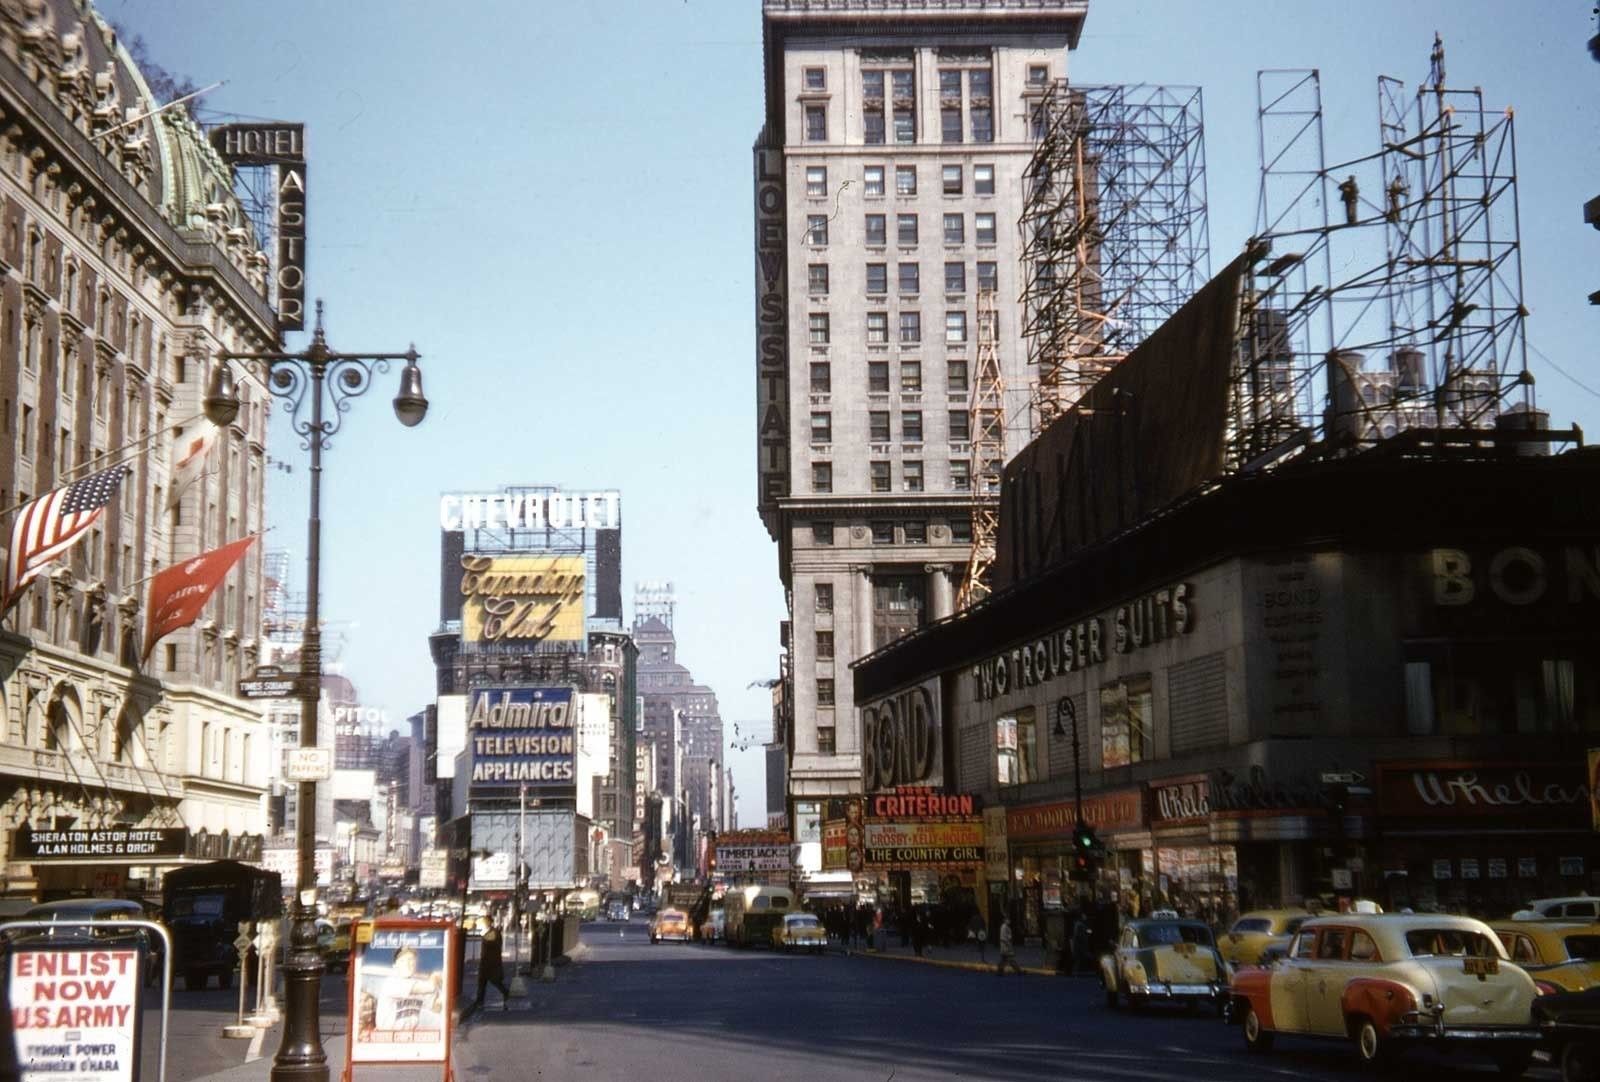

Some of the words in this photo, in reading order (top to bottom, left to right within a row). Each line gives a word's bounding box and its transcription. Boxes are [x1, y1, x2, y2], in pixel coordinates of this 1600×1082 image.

[226, 129, 304, 155] HOTEL
[277, 169, 305, 322] ASTOR
[758, 150, 785, 324] LOEW'S
[761, 335, 786, 498] STATE
[440, 491, 620, 531] CHEVROLET
[460, 553, 585, 602] Canadian
[484, 596, 562, 642] Club
[973, 655, 1009, 702] TWO
[1012, 616, 1106, 691] TROUSER
[1115, 582, 1197, 656] SUITS
[240, 681, 263, 691] TIMES
[264, 681, 294, 691] SQUARE
[469, 690, 577, 729] Admiral
[475, 735, 573, 756] TELEVISION
[863, 685, 937, 792] BOND
[299, 752, 319, 762] NO
[291, 765, 326, 773] PARKING
[473, 760, 573, 781] APPLIANCES
[875, 794, 973, 817] CRITERION
[31, 832, 88, 843] SHERATON
[91, 832, 126, 842] ASTOR
[129, 831, 164, 841] HOTEL
[37, 844, 68, 855] ALAN
[70, 843, 113, 854] HOLMES
[115, 844, 124, 853] &
[126, 843, 155, 853] ORCH
[872, 850, 891, 861] THE
[896, 849, 949, 861] COUNTRY
[953, 848, 981, 860] GIRL
[17, 952, 134, 977] ENLIST
[34, 980, 116, 1001] NOW
[76, 1043, 116, 1056] POWER
[81, 1058, 120, 1072] O'HARA
